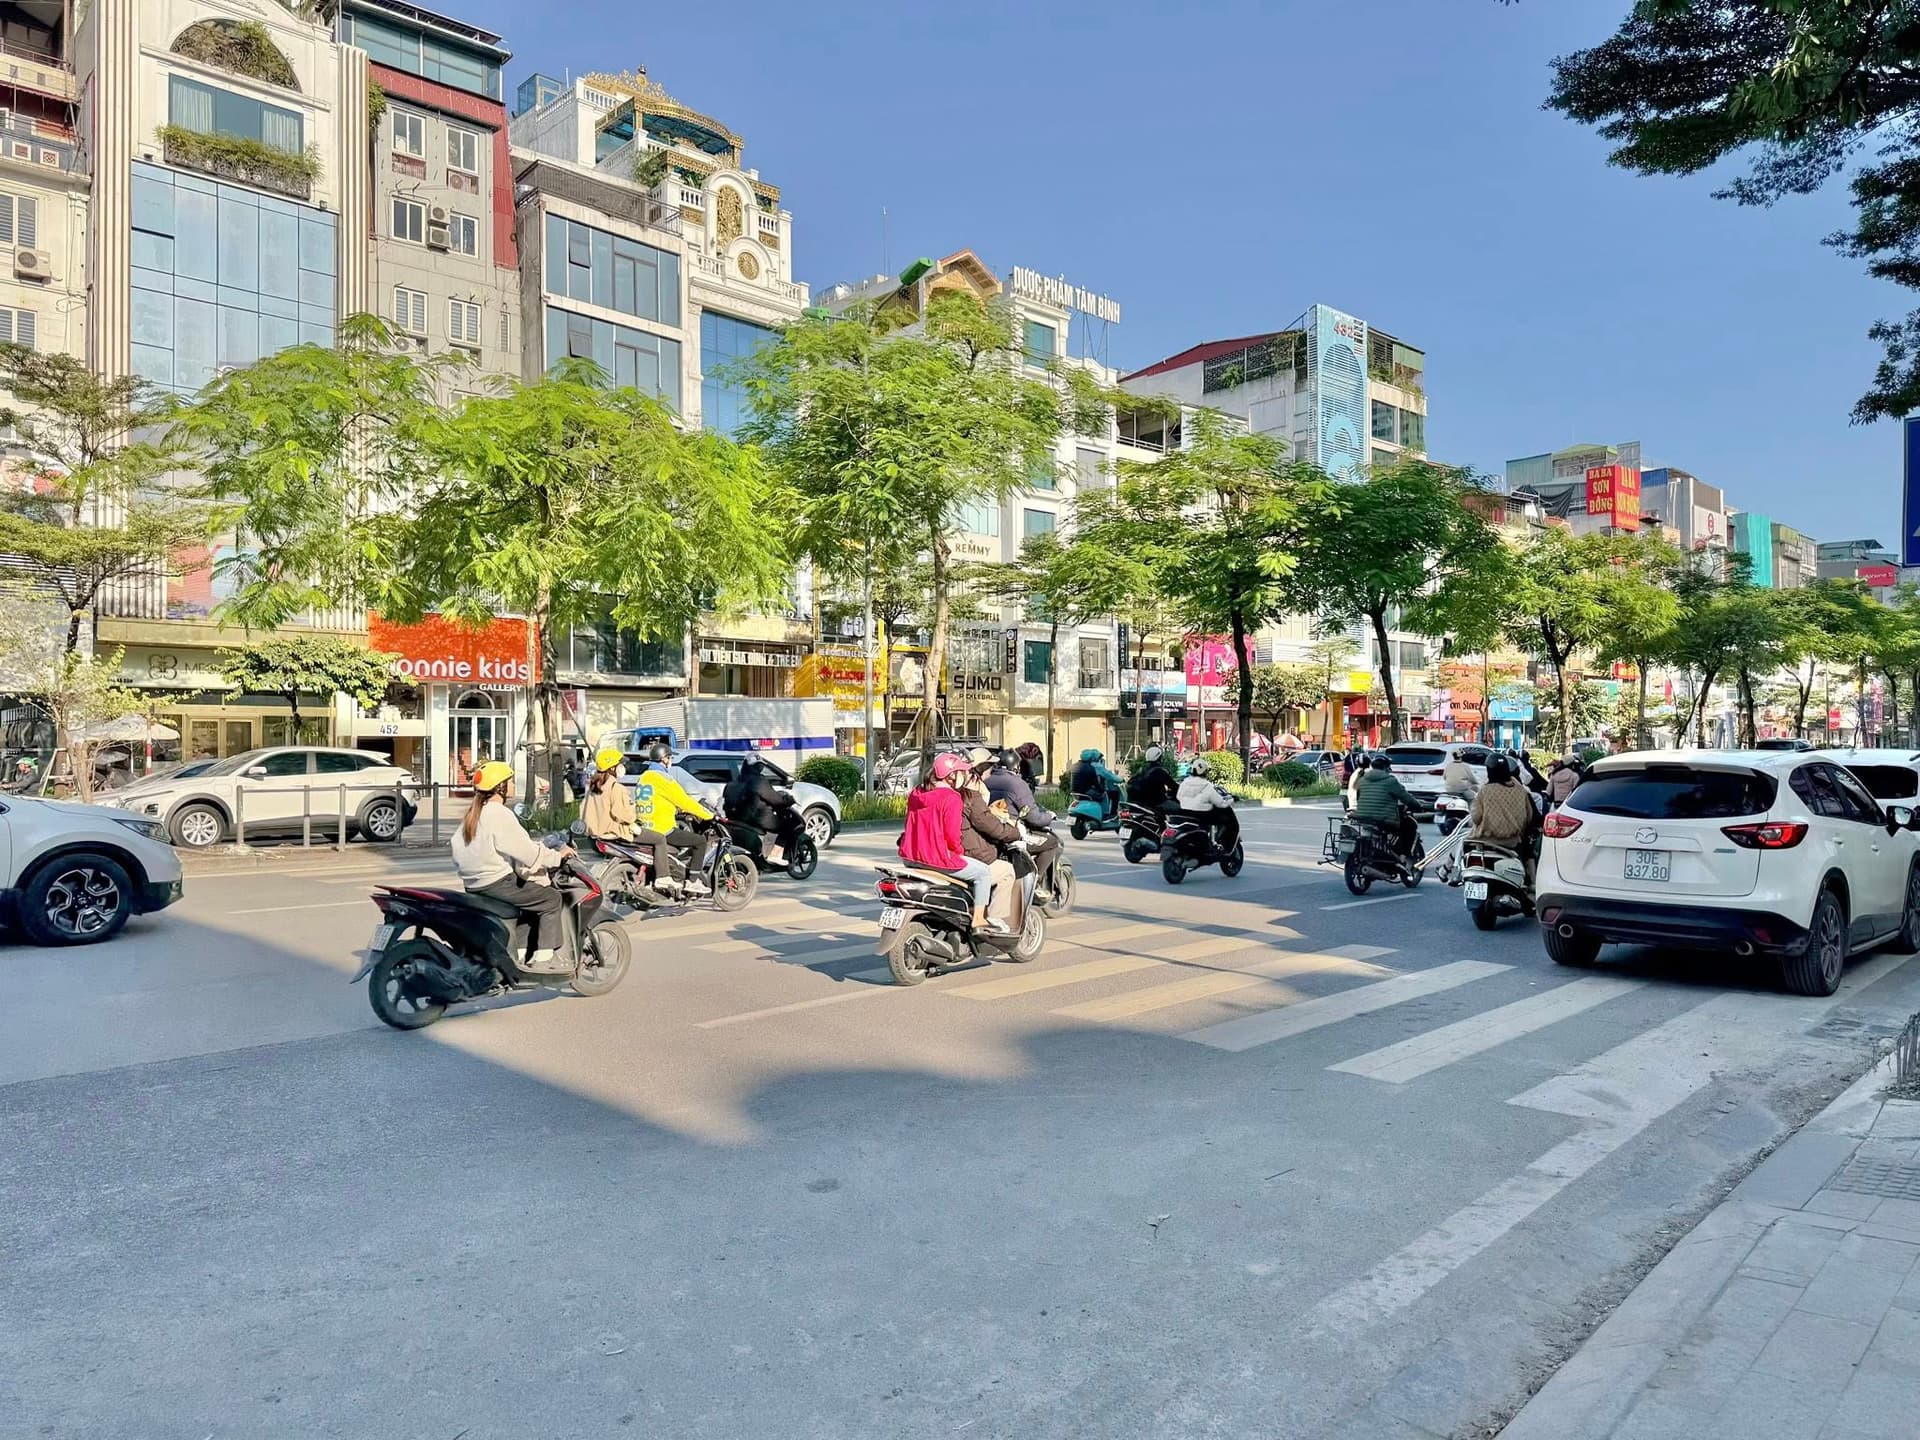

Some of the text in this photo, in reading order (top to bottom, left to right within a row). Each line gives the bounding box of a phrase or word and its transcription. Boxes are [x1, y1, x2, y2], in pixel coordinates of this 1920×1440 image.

[1013, 264, 1120, 325] DƯỢC PHẨM TÂM BÌNH
[1592, 479, 1610, 495] SƠN
[479, 656, 529, 680] kids
[479, 683, 523, 692] GALLERY
[953, 675, 1002, 691] SUMO
[380, 725, 399, 735] 452
[1636, 851, 1660, 864] 30E
[1626, 865, 1667, 880] 337.80
